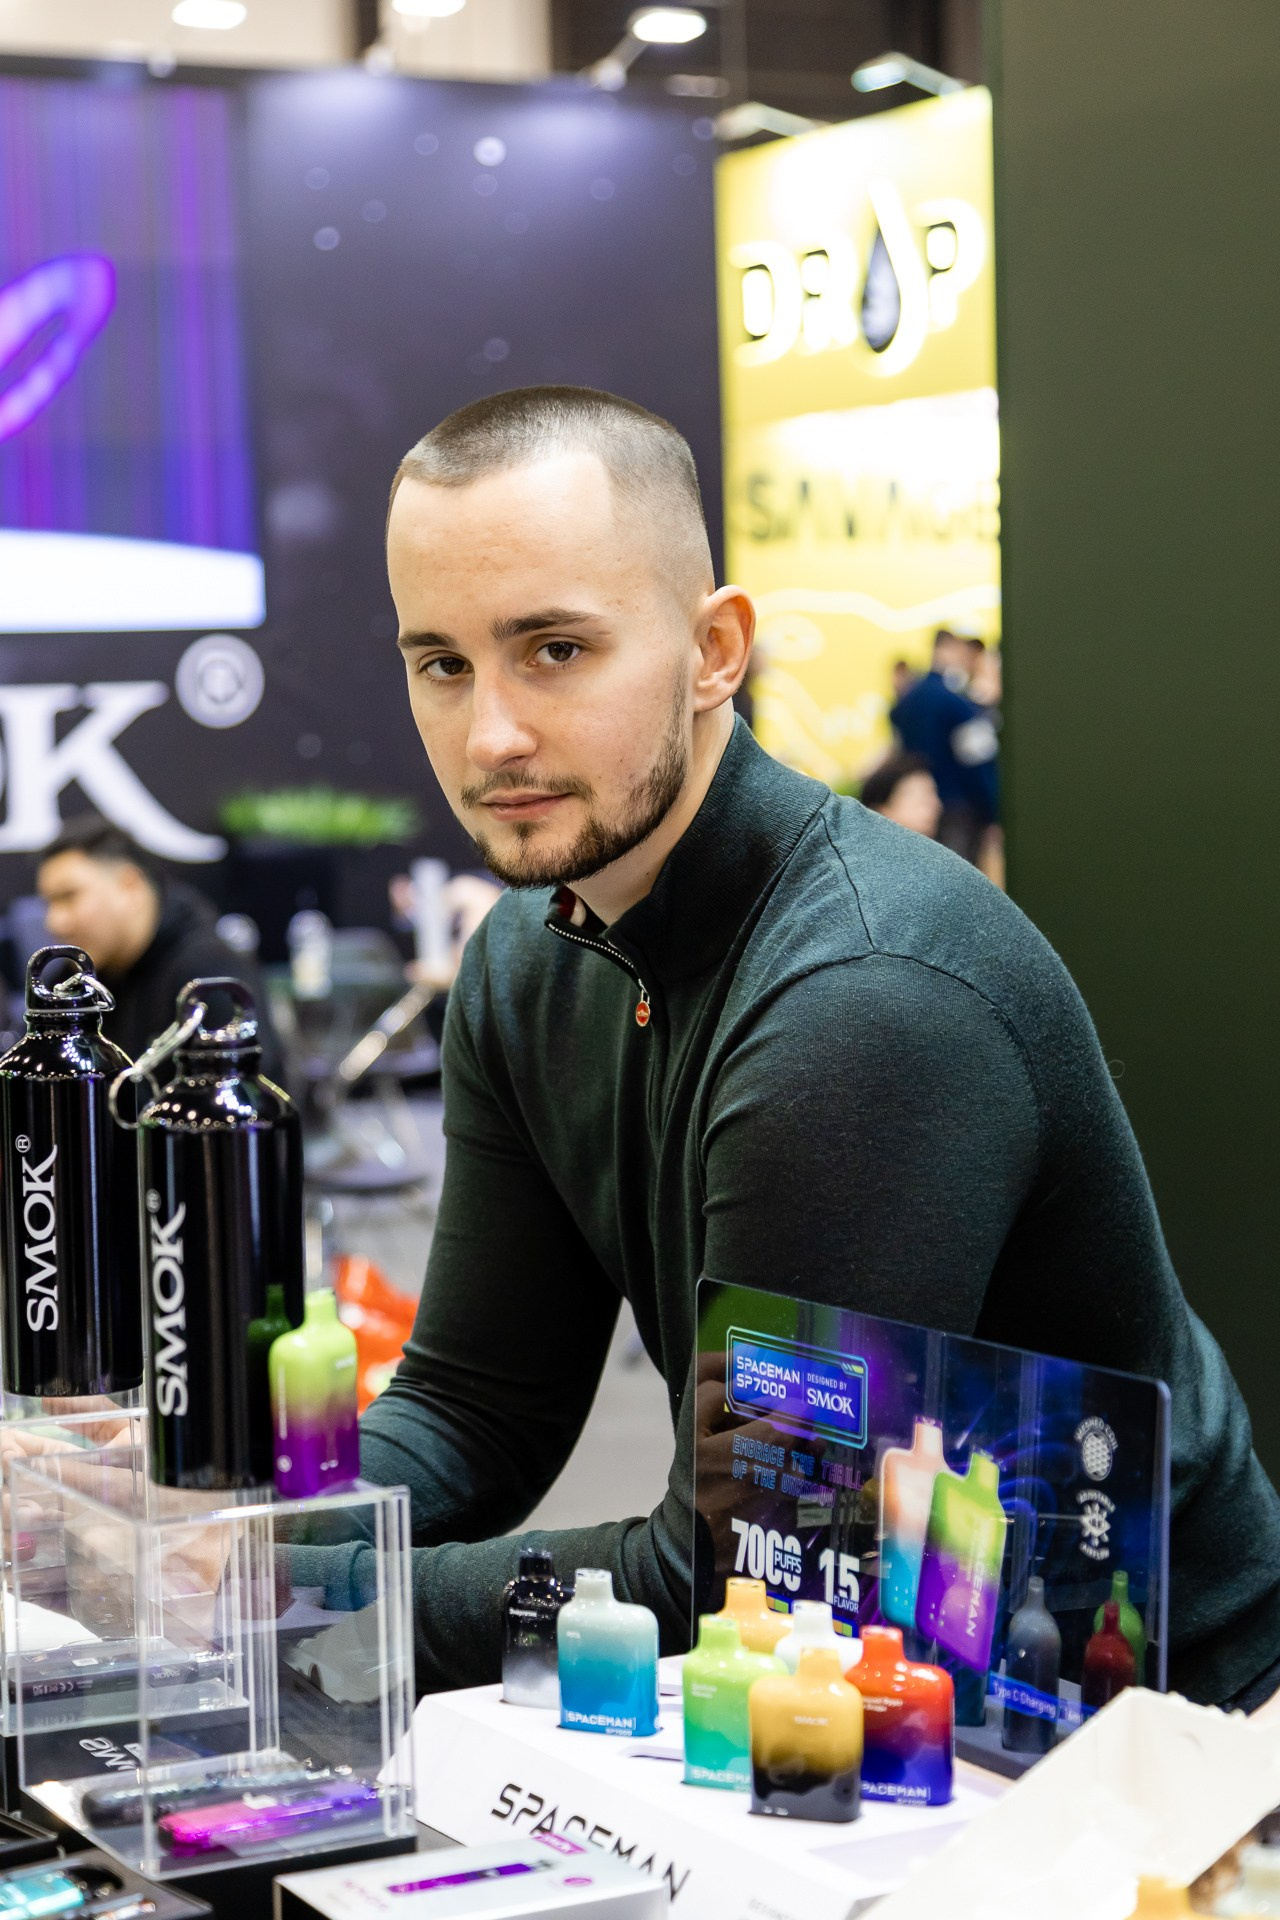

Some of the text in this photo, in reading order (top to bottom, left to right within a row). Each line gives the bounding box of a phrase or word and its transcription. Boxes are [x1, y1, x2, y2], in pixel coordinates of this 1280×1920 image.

[736, 1355, 800, 1384] SPACEMAN
[807, 1373, 848, 1391] DESIGNED BY
[736, 1373, 787, 1399] SP7000
[807, 1387, 855, 1418] SMOK
[732, 1459, 748, 1479] OF
[753, 1465, 777, 1490] THE
[733, 1434, 864, 1491] EMBRACE THE THRILL
[775, 1551, 802, 1574] PUFFS
[819, 1547, 860, 1604] 15
[1021, 1692, 1056, 1719] Charging
[568, 1711, 633, 1728] SPACEMAN
[692, 1767, 751, 1784] SPACEM
[862, 1782, 927, 1798] PACEMAN
